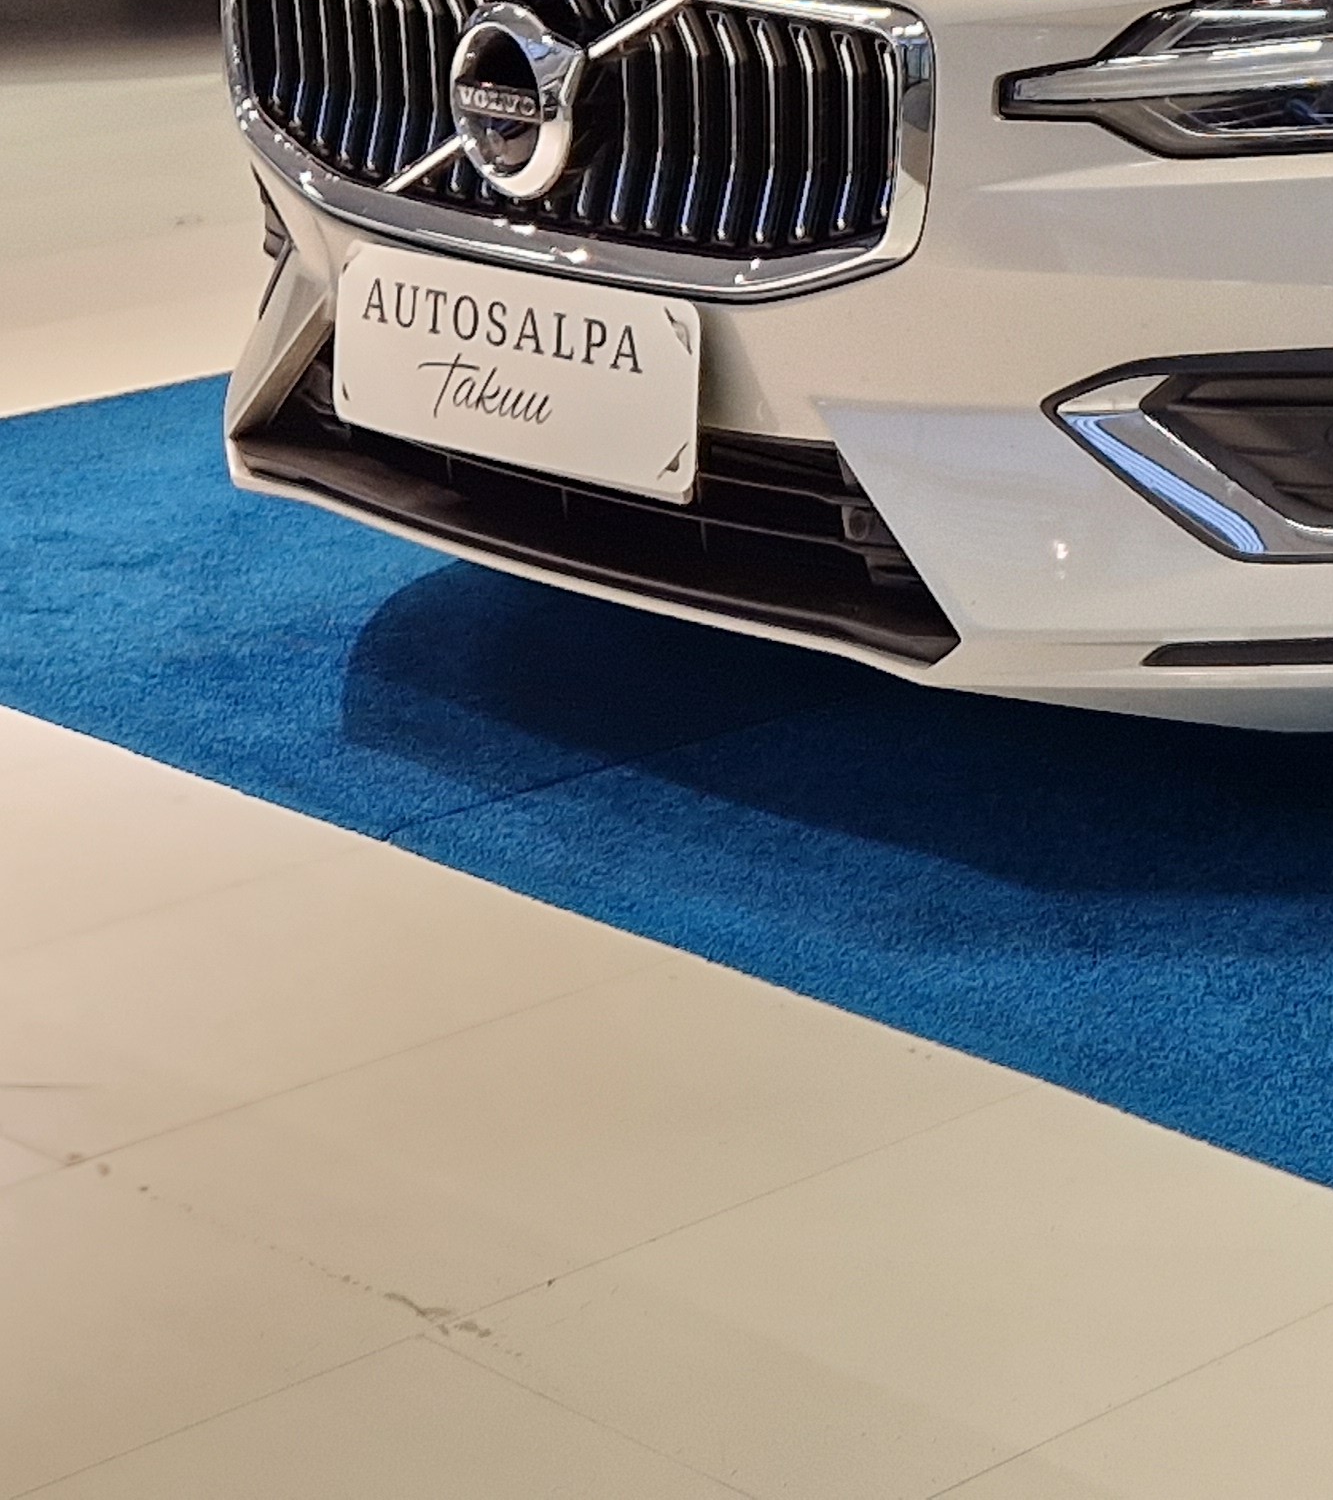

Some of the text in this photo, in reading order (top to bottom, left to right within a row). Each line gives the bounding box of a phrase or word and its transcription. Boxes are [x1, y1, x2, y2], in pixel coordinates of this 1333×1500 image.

[456, 84, 537, 117] VOLVO
[361, 277, 644, 374] AUTOSALPA
[417, 352, 553, 425] Takuu
